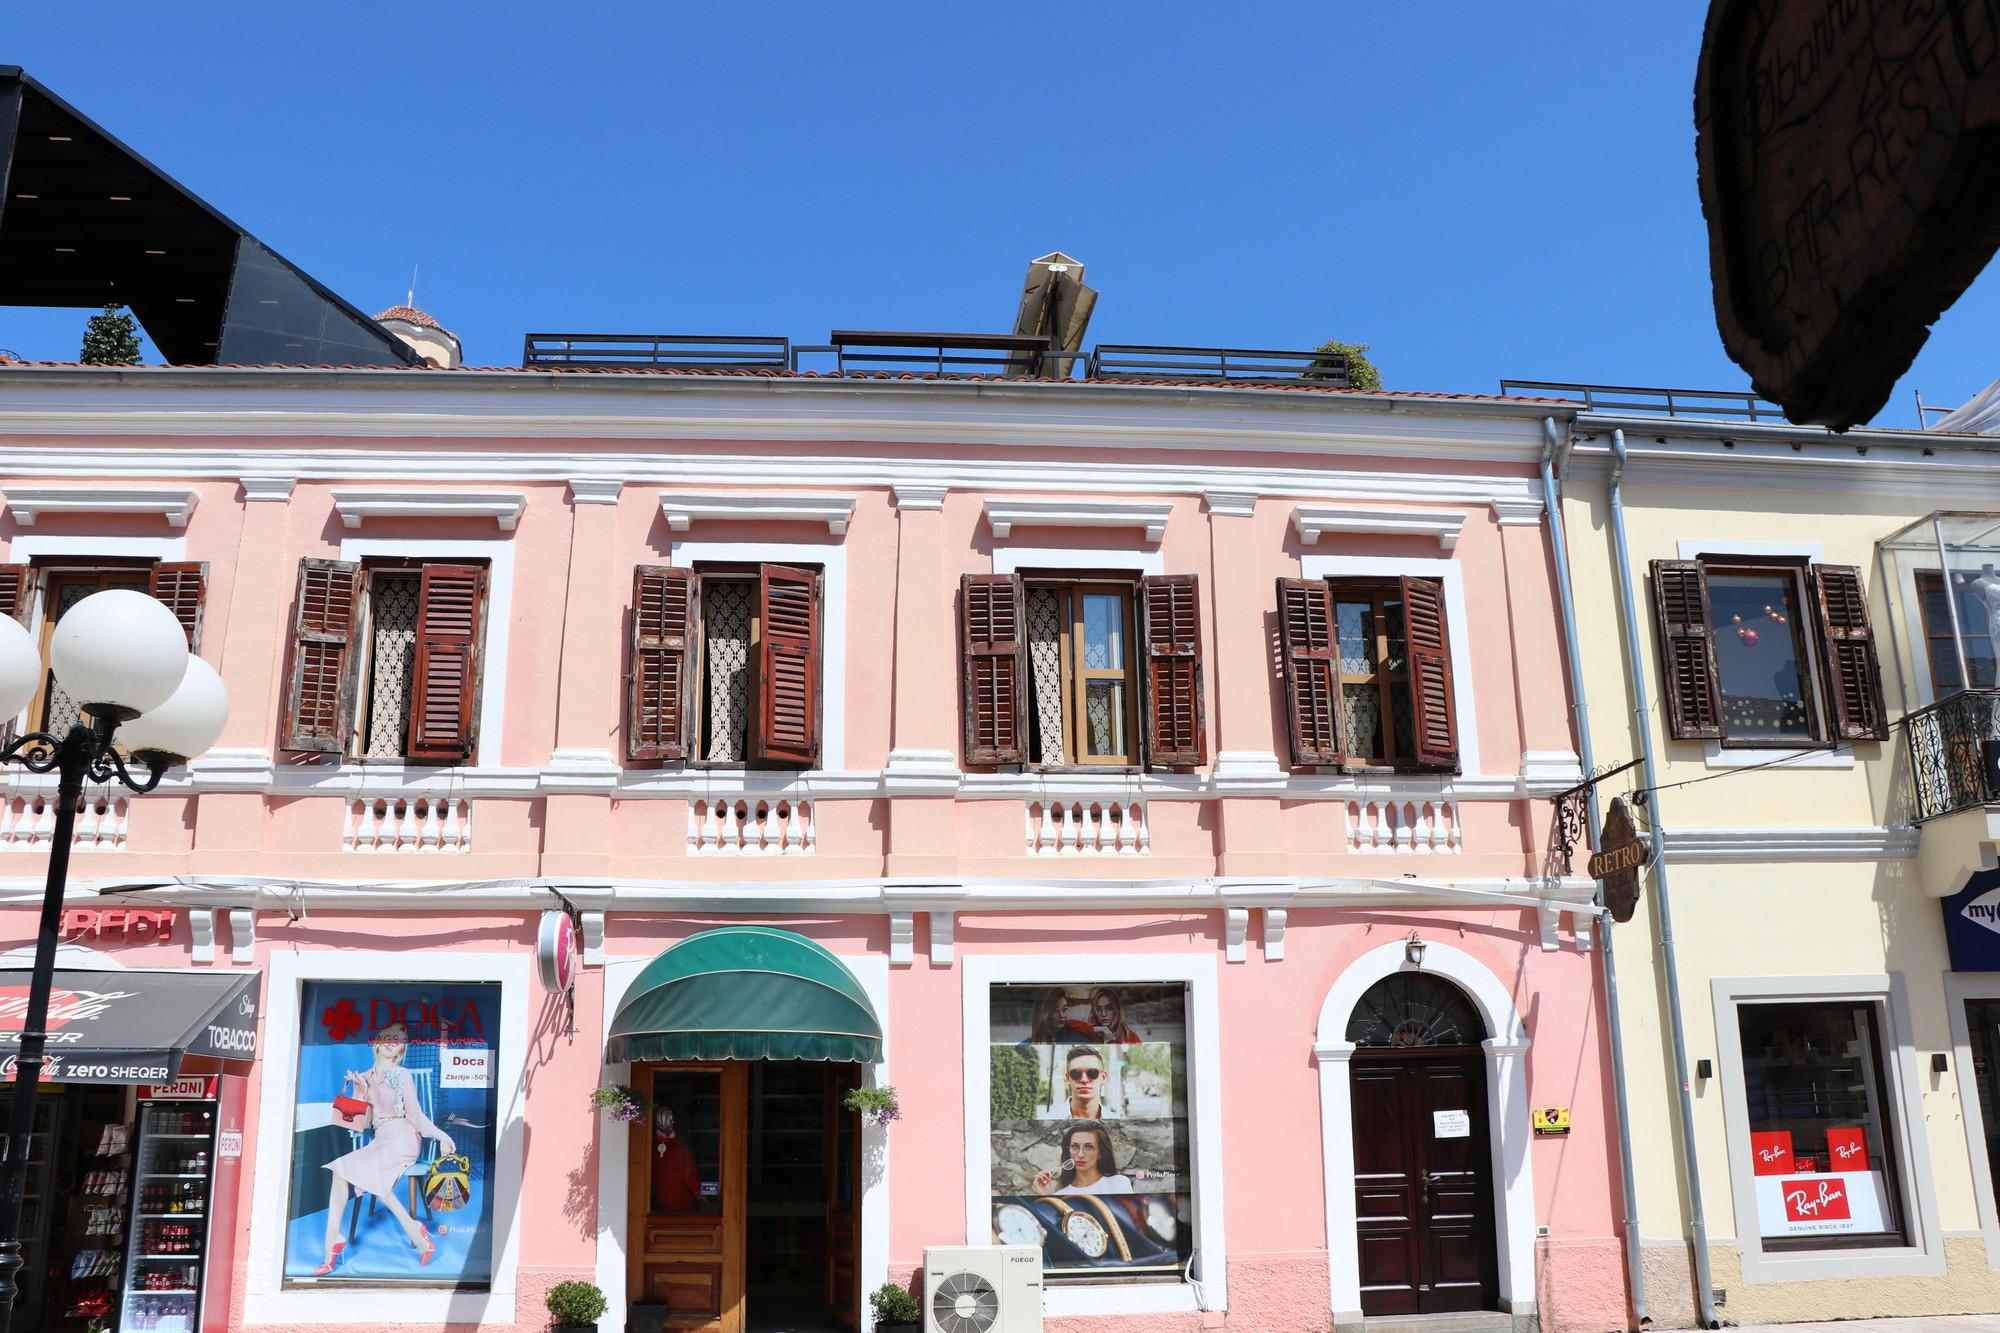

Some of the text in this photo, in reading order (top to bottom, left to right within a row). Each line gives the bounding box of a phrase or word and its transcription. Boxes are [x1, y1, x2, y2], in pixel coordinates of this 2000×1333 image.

[1594, 842, 1640, 876] RETRO
[1968, 901, 2000, 923] my
[59, 909, 173, 942] REDI
[368, 999, 484, 1032] DOCA
[208, 1025, 256, 1051] TOBACCO
[453, 1056, 485, 1066] Doca
[67, 1065, 108, 1078] zero
[110, 1066, 168, 1079] SHEQER
[153, 1082, 202, 1094] PERONI
[221, 1137, 241, 1151] PERONI
[1759, 1145, 1785, 1162] Ray-Ban
[1835, 1142, 1862, 1159] Ray-Ban
[1786, 1181, 1843, 1216] Ray-Ban
